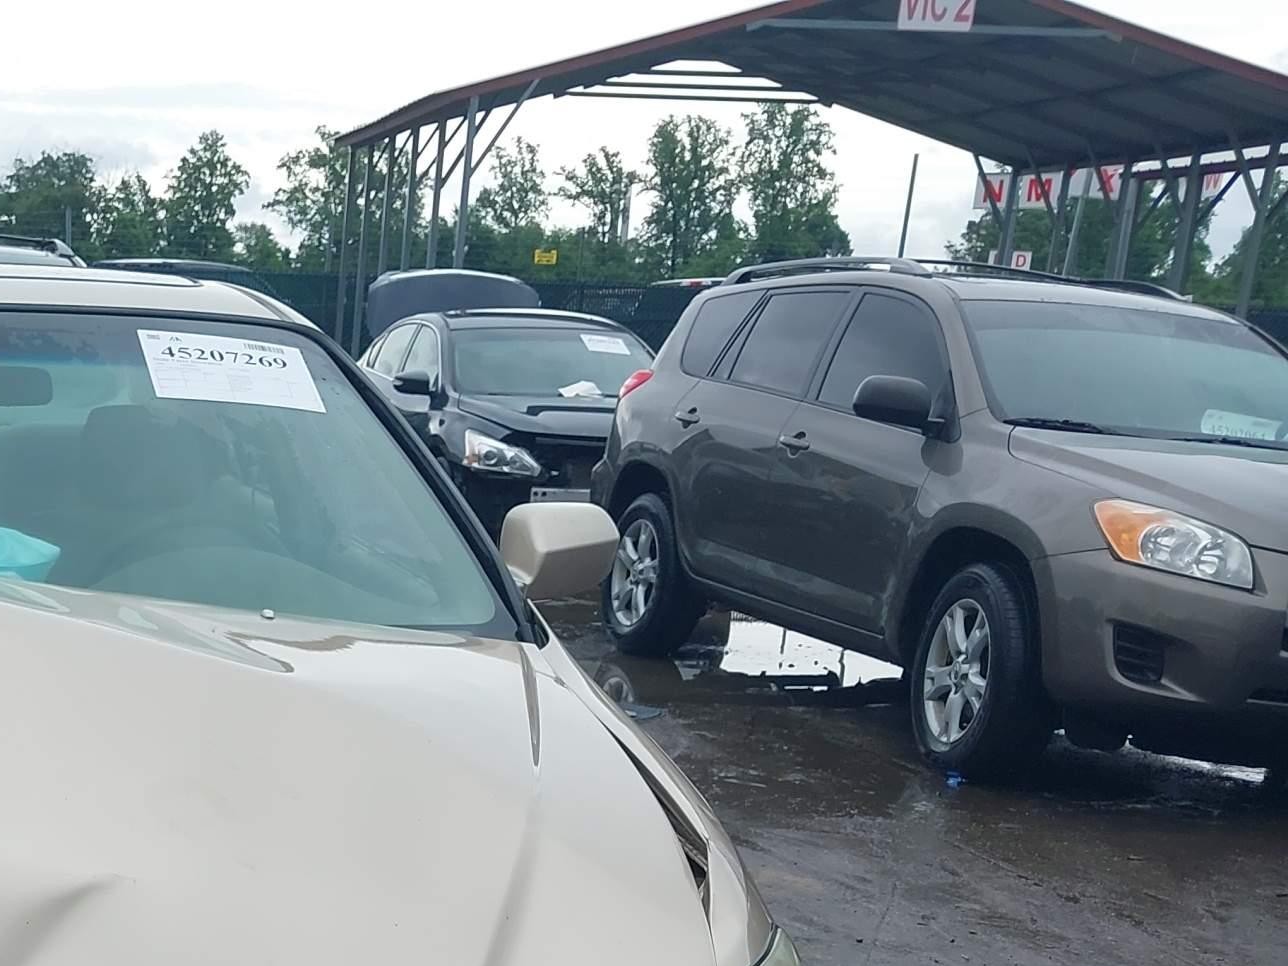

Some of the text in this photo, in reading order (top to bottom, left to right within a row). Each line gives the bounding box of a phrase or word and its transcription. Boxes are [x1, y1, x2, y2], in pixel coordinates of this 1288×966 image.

[983, 179, 1004, 203] N
[1027, 177, 1053, 202] M
[1015, 254, 1027, 268] D
[160, 345, 288, 370] 45207269
